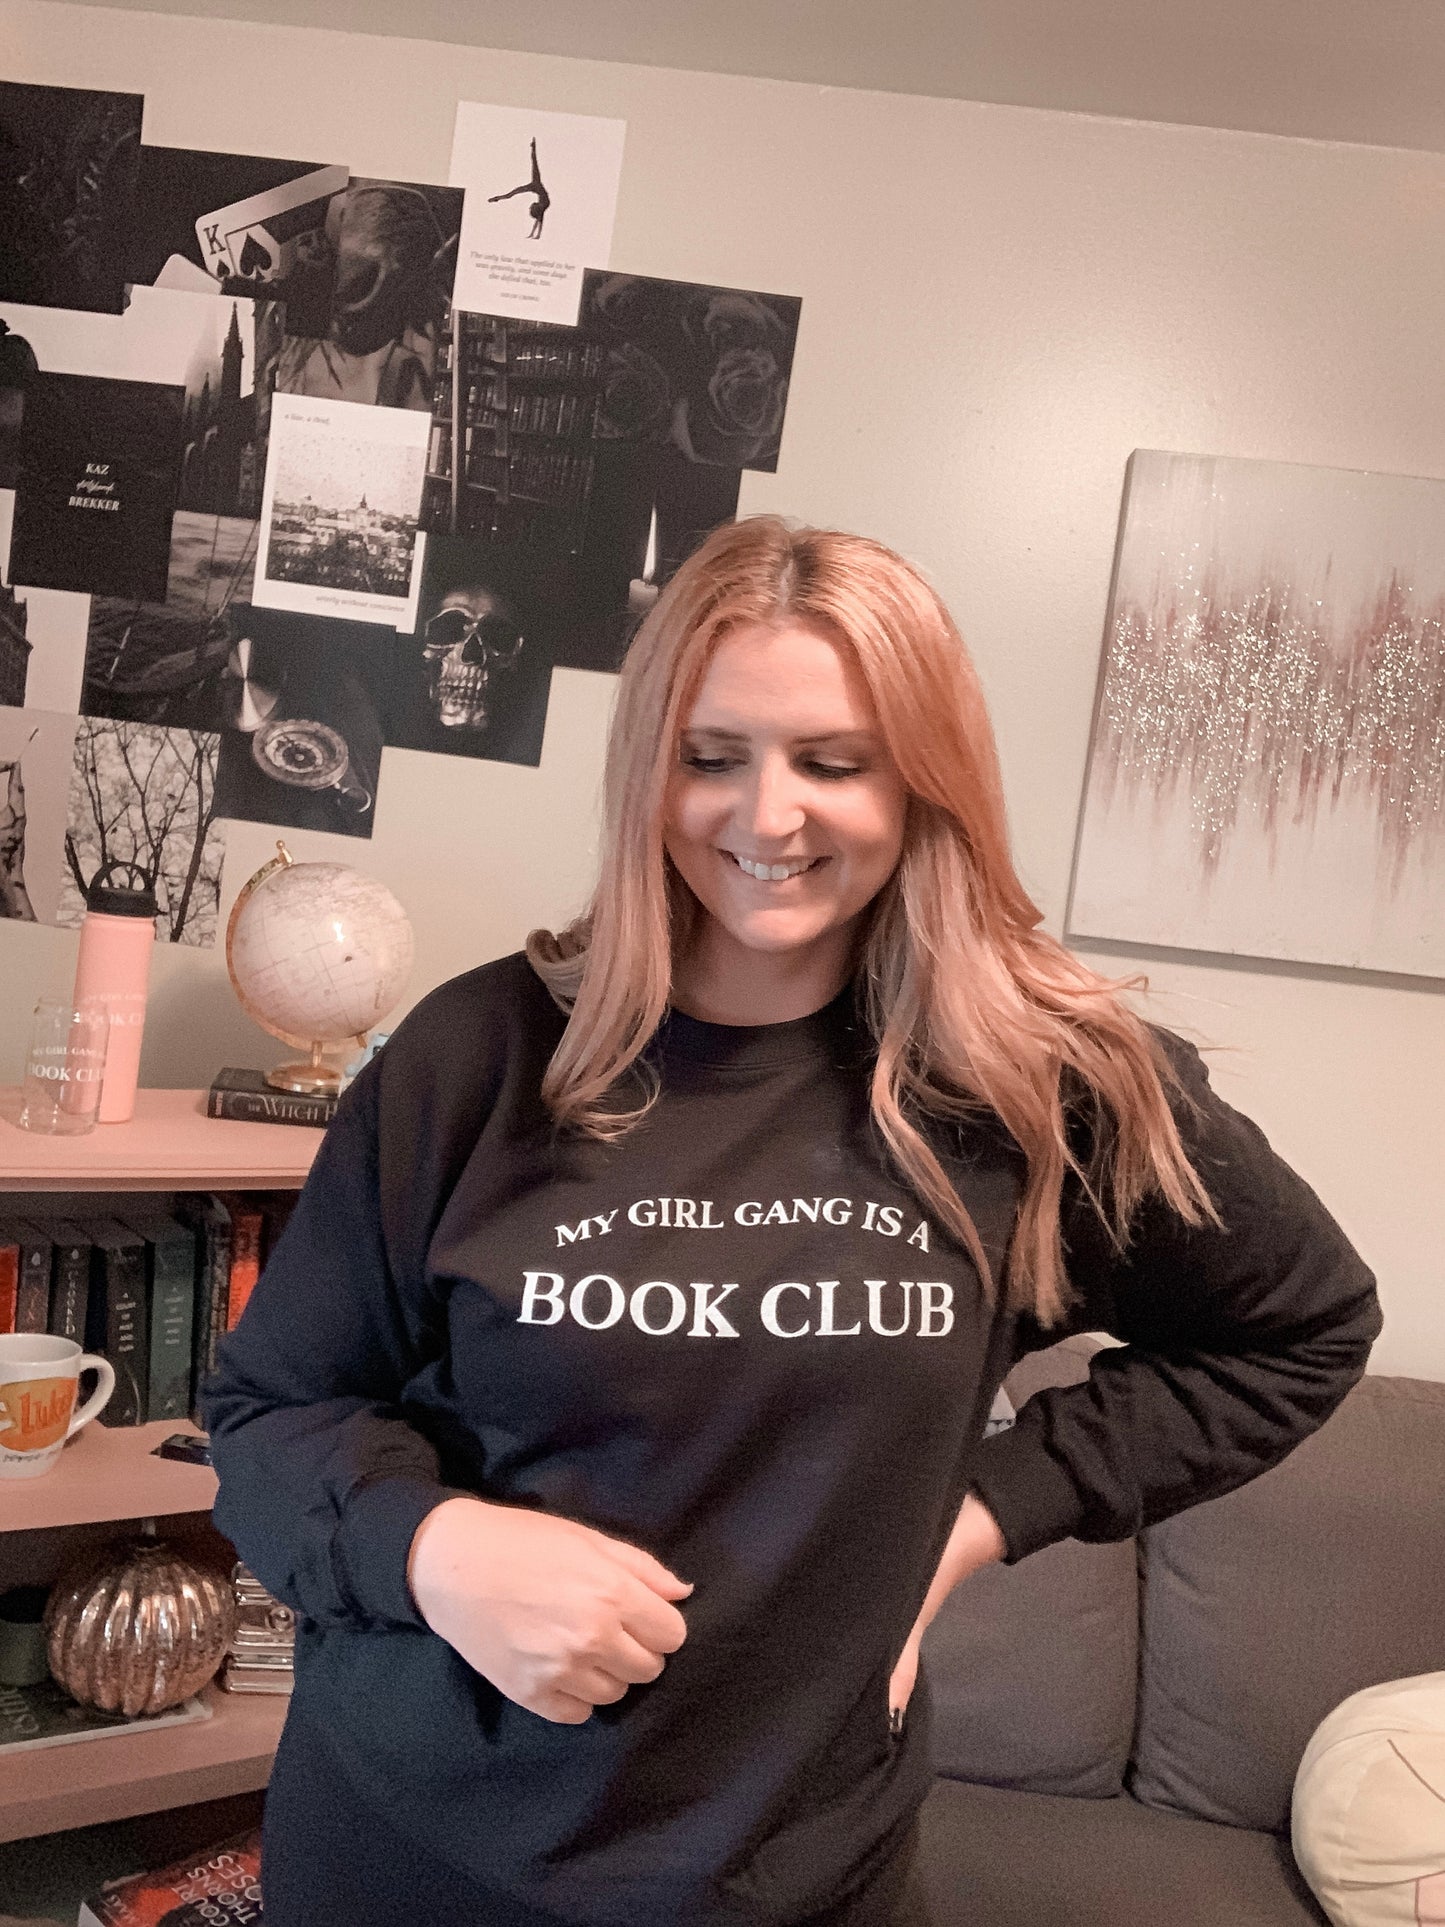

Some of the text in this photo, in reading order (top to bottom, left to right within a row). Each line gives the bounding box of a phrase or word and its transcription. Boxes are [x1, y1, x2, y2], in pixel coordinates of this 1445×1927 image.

[203, 223, 226, 256] K
[85, 463, 110, 475] KAZ
[68, 496, 120, 511] BREKKER
[554, 1197, 931, 1254] MY GIRL GANG IS A
[516, 1270, 956, 1339] BOOK CLUB
[171, 1883, 230, 1927] COURT
[187, 1866, 257, 1926] THORNS
[208, 1854, 264, 1912] OSES
